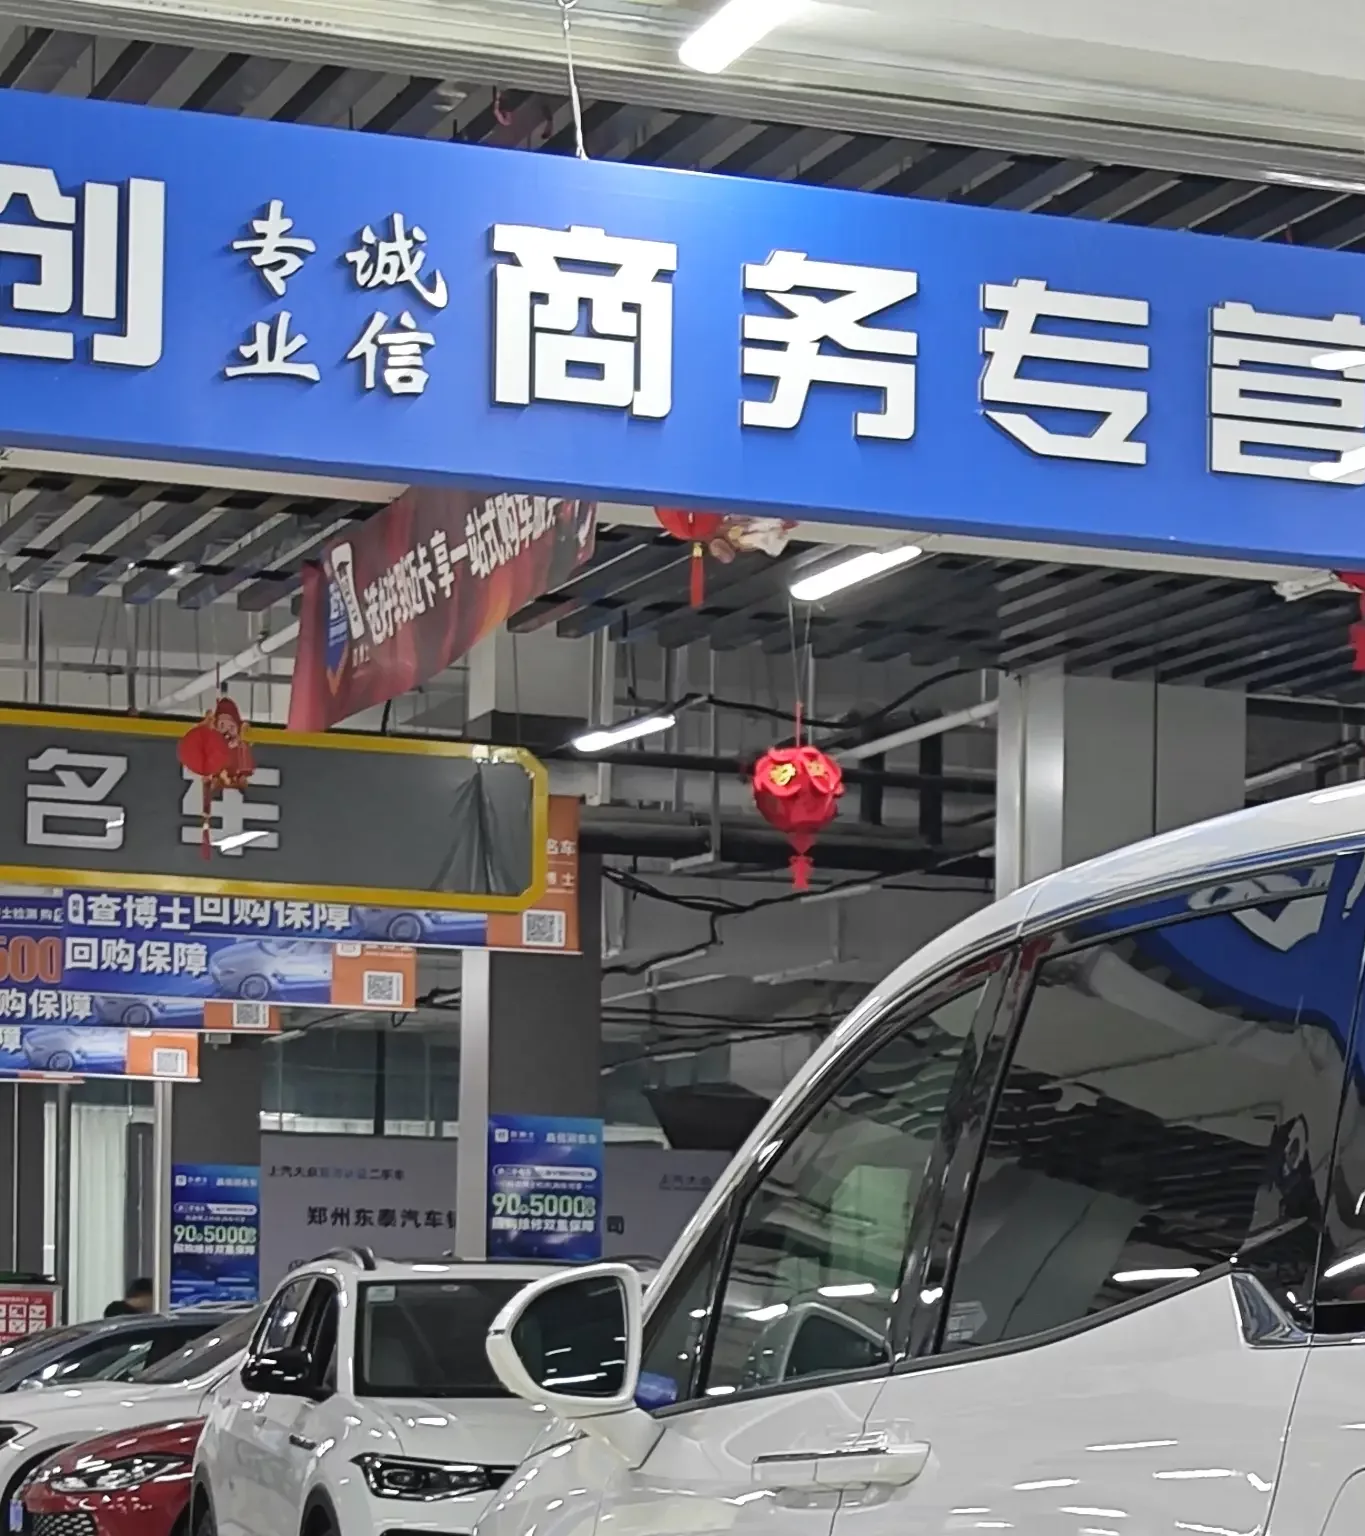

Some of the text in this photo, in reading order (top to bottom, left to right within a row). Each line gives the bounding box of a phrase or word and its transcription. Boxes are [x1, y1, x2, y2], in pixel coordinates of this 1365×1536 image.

[86, 893, 192, 931] 查博士
[192, 896, 353, 932] 回购保障
[65, 936, 208, 976] 回购保障
